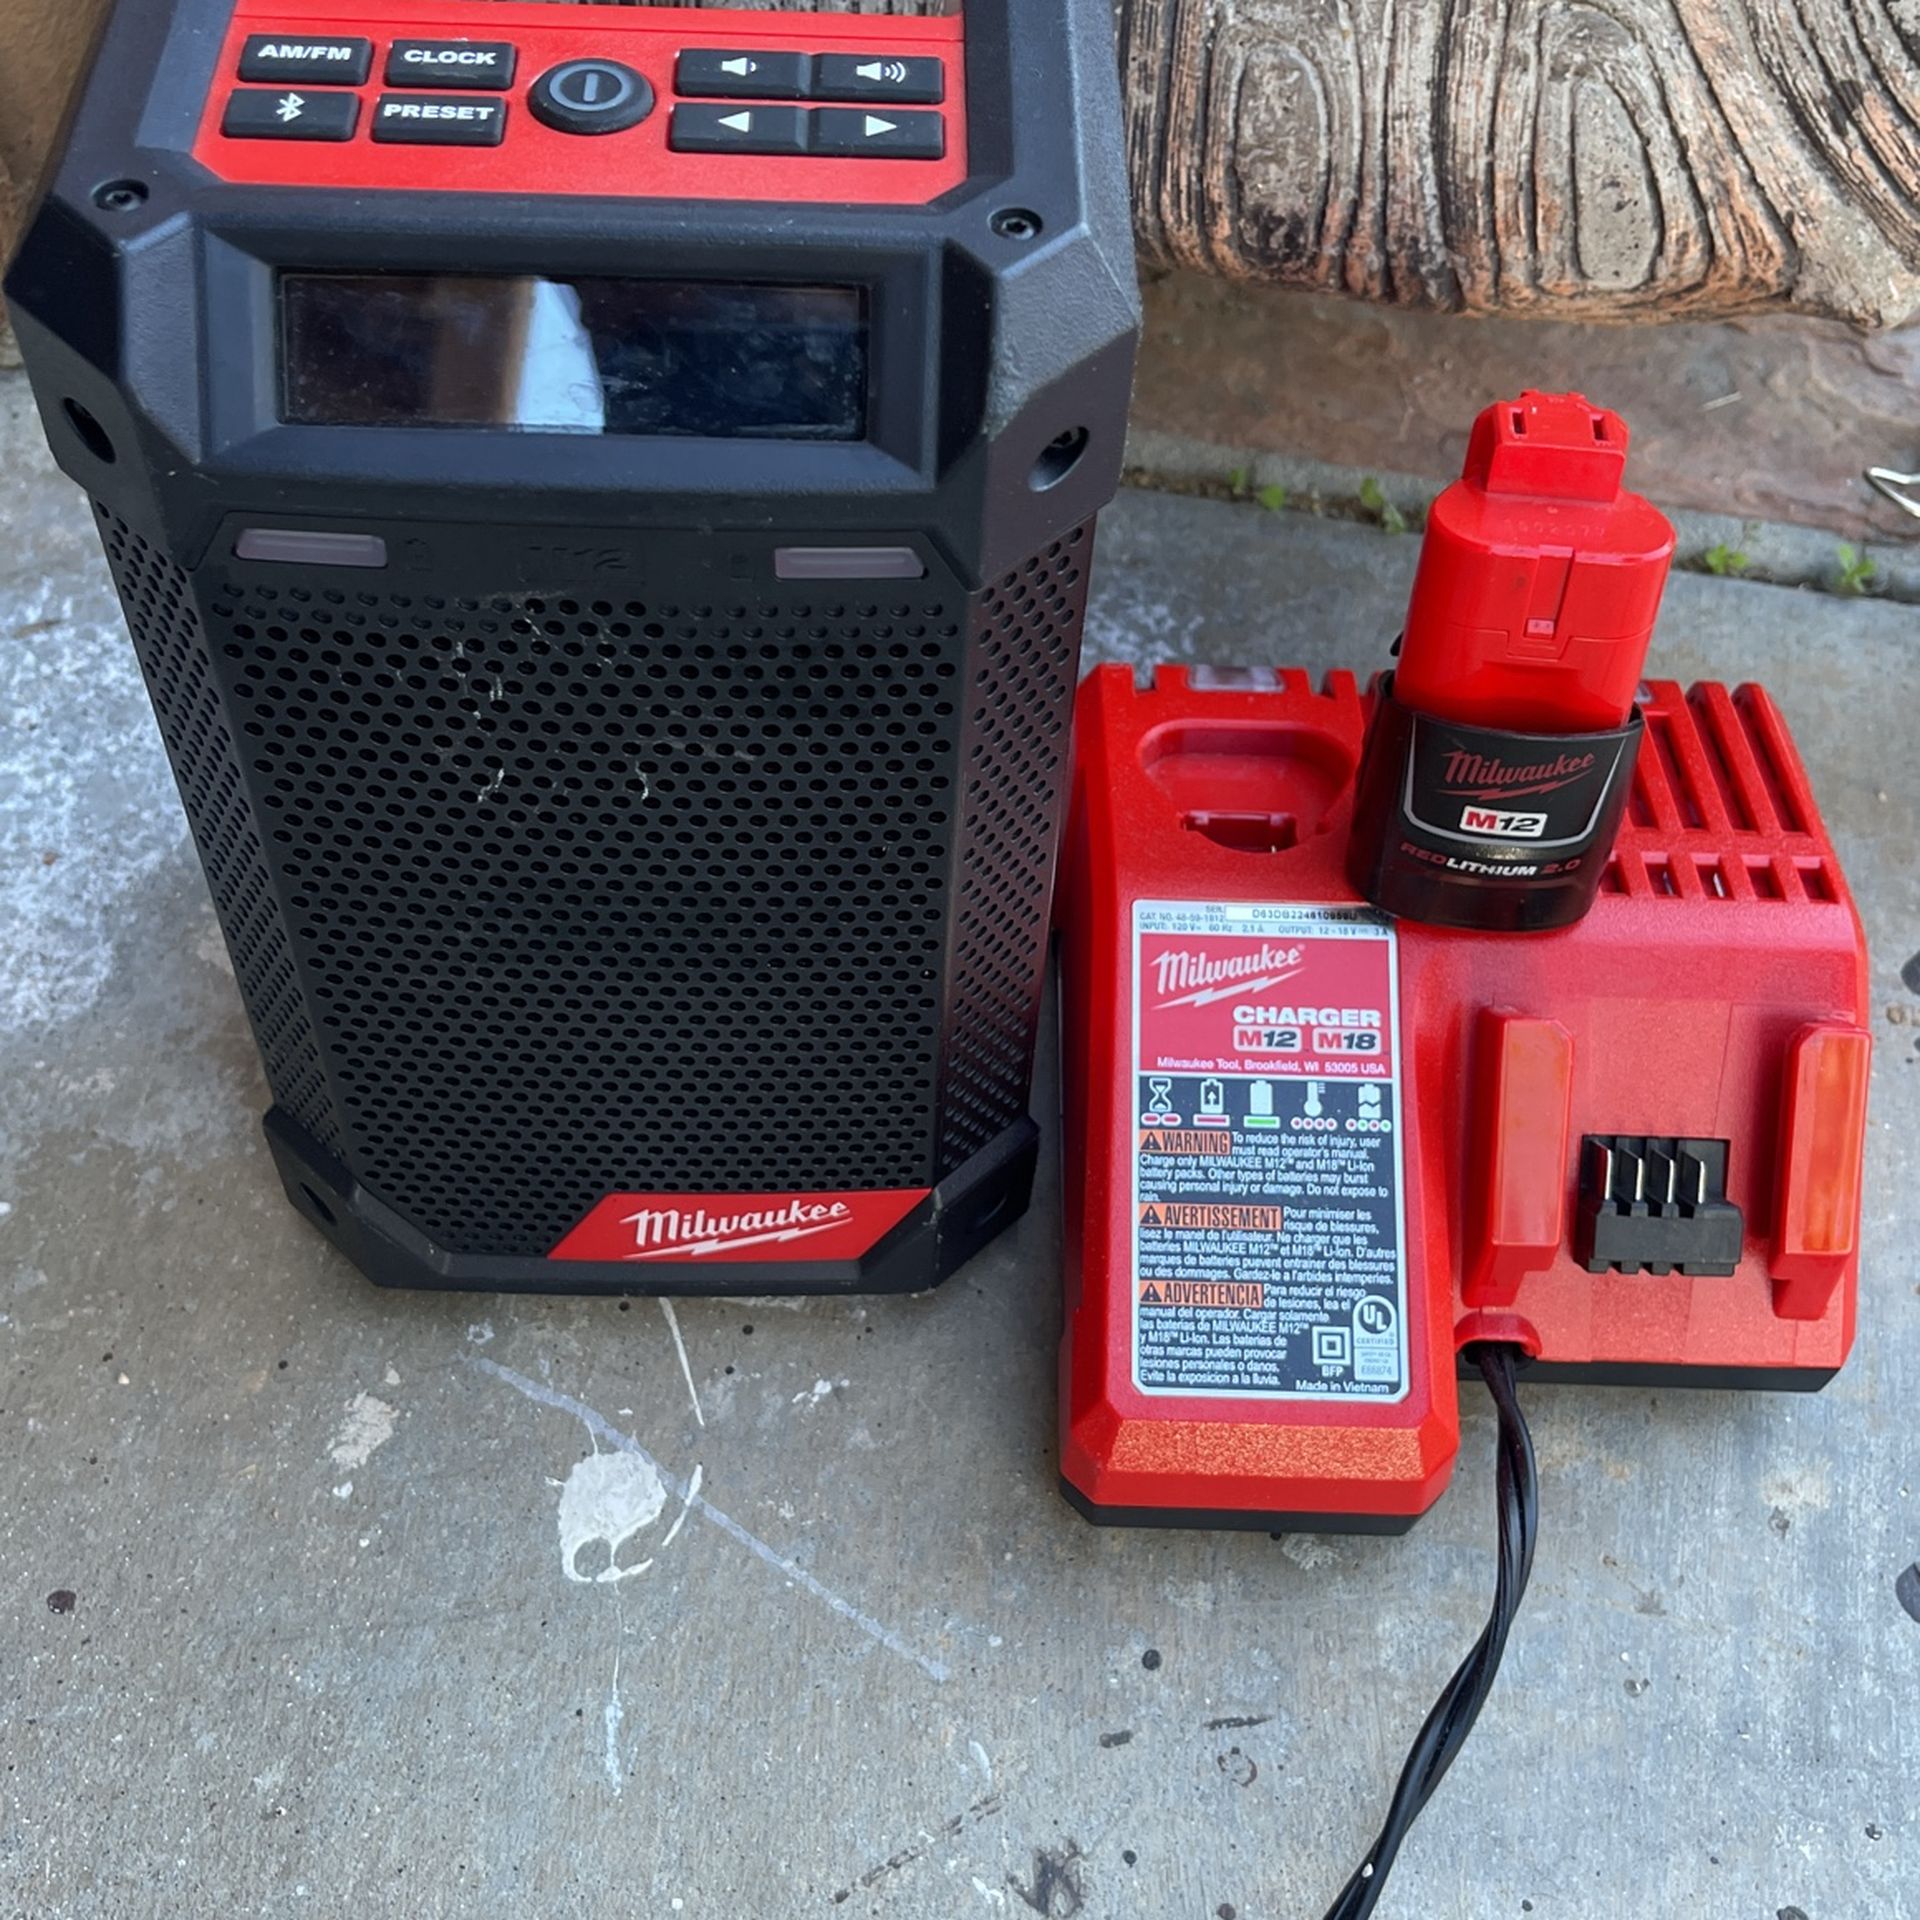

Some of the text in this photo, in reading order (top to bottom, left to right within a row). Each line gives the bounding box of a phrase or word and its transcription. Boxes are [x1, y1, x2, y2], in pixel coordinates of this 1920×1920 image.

[257, 44, 352, 61] AM/FM
[403, 49, 497, 65] CLOCK
[383, 103, 494, 120] PRESET
[1440, 750, 1596, 786] Milwaukee
[1464, 809, 1541, 832] M12
[1400, 842, 1582, 877] REDLITHIUM 2.0
[1257, 924, 1264, 933] A
[1150, 943, 1303, 996] Milwaukee
[1233, 1005, 1382, 1028] CHARGER
[1237, 1028, 1377, 1050] M12 M18
[1157, 1057, 1386, 1075] Milwaukee Tool, Brookfield, WI 53005 USA
[1162, 1131, 1381, 1154] WARNING To reduce the risk of injury, user
[1232, 1145, 1370, 1160] must read operator's manual.
[1140, 1153, 1176, 1168] Charge
[1176, 1155, 1198, 1170] only
[1199, 1155, 1263, 1169] MILWAUKEE
[1295, 1158, 1314, 1171] and
[1140, 1167, 1370, 1185] battery packs. Other types of batteries may burst
[1140, 1180, 1389, 1199] causing personal injury or damage. Do not expose to
[1140, 1191, 1161, 1202] rain.
[619, 1199, 851, 1247] Milwaukee
[1164, 1205, 1372, 1229] AVERTISSEMENT Pour minimiser les
[1283, 1219, 1380, 1235] risque de blessures,
[1163, 1228, 1174, 1240] le
[1207, 1229, 1220, 1240] de
[1276, 1232, 1291, 1243] Ne
[1293, 1233, 1330, 1246] charger
[1331, 1235, 1352, 1246] que
[1352, 1234, 1369, 1245] les
[1140, 1240, 1182, 1252] batteries
[1183, 1241, 1248, 1254] MILWAUKEE
[1280, 1244, 1291, 1256] et
[1355, 1247, 1397, 1259] D'autres
[1140, 1254, 1182, 1266] marques
[1184, 1254, 1197, 1266] de
[1198, 1254, 1241, 1267] batteries
[1328, 1258, 1347, 1270] des
[1348, 1259, 1396, 1272] blessures
[1140, 1267, 1153, 1277] ou
[1154, 1266, 1173, 1278] des
[1174, 1266, 1232, 1281] dommages.
[1233, 1267, 1281, 1281] Gardez-le
[1164, 1282, 1366, 1306] ADVERTENCIA Para reducir el riesgo
[1263, 1297, 1351, 1311] de lesiones, lea el
[1140, 1307, 1330, 1323] manual del operador. Cargar solamente
[1362, 1304, 1388, 1331] UL
[1140, 1318, 1154, 1330] las
[1156, 1318, 1196, 1331] baterias
[1197, 1320, 1211, 1332] de
[1212, 1320, 1277, 1334] MILWAUKEE
[1140, 1333, 1147, 1344] y
[1212, 1333, 1231, 1345] Las
[1232, 1334, 1272, 1346] baterias
[1273, 1335, 1288, 1347] de
[1140, 1345, 1288, 1361] otras marcas pueden provocar
[1140, 1357, 1180, 1369] lesiones
[1181, 1359, 1236, 1371] personales
[1237, 1361, 1245, 1370] o
[1321, 1365, 1344, 1378] BFP
[1140, 1369, 1281, 1386] Evite la exposicion a la lluvia.
[1295, 1379, 1390, 1394] Made in Vietnam
